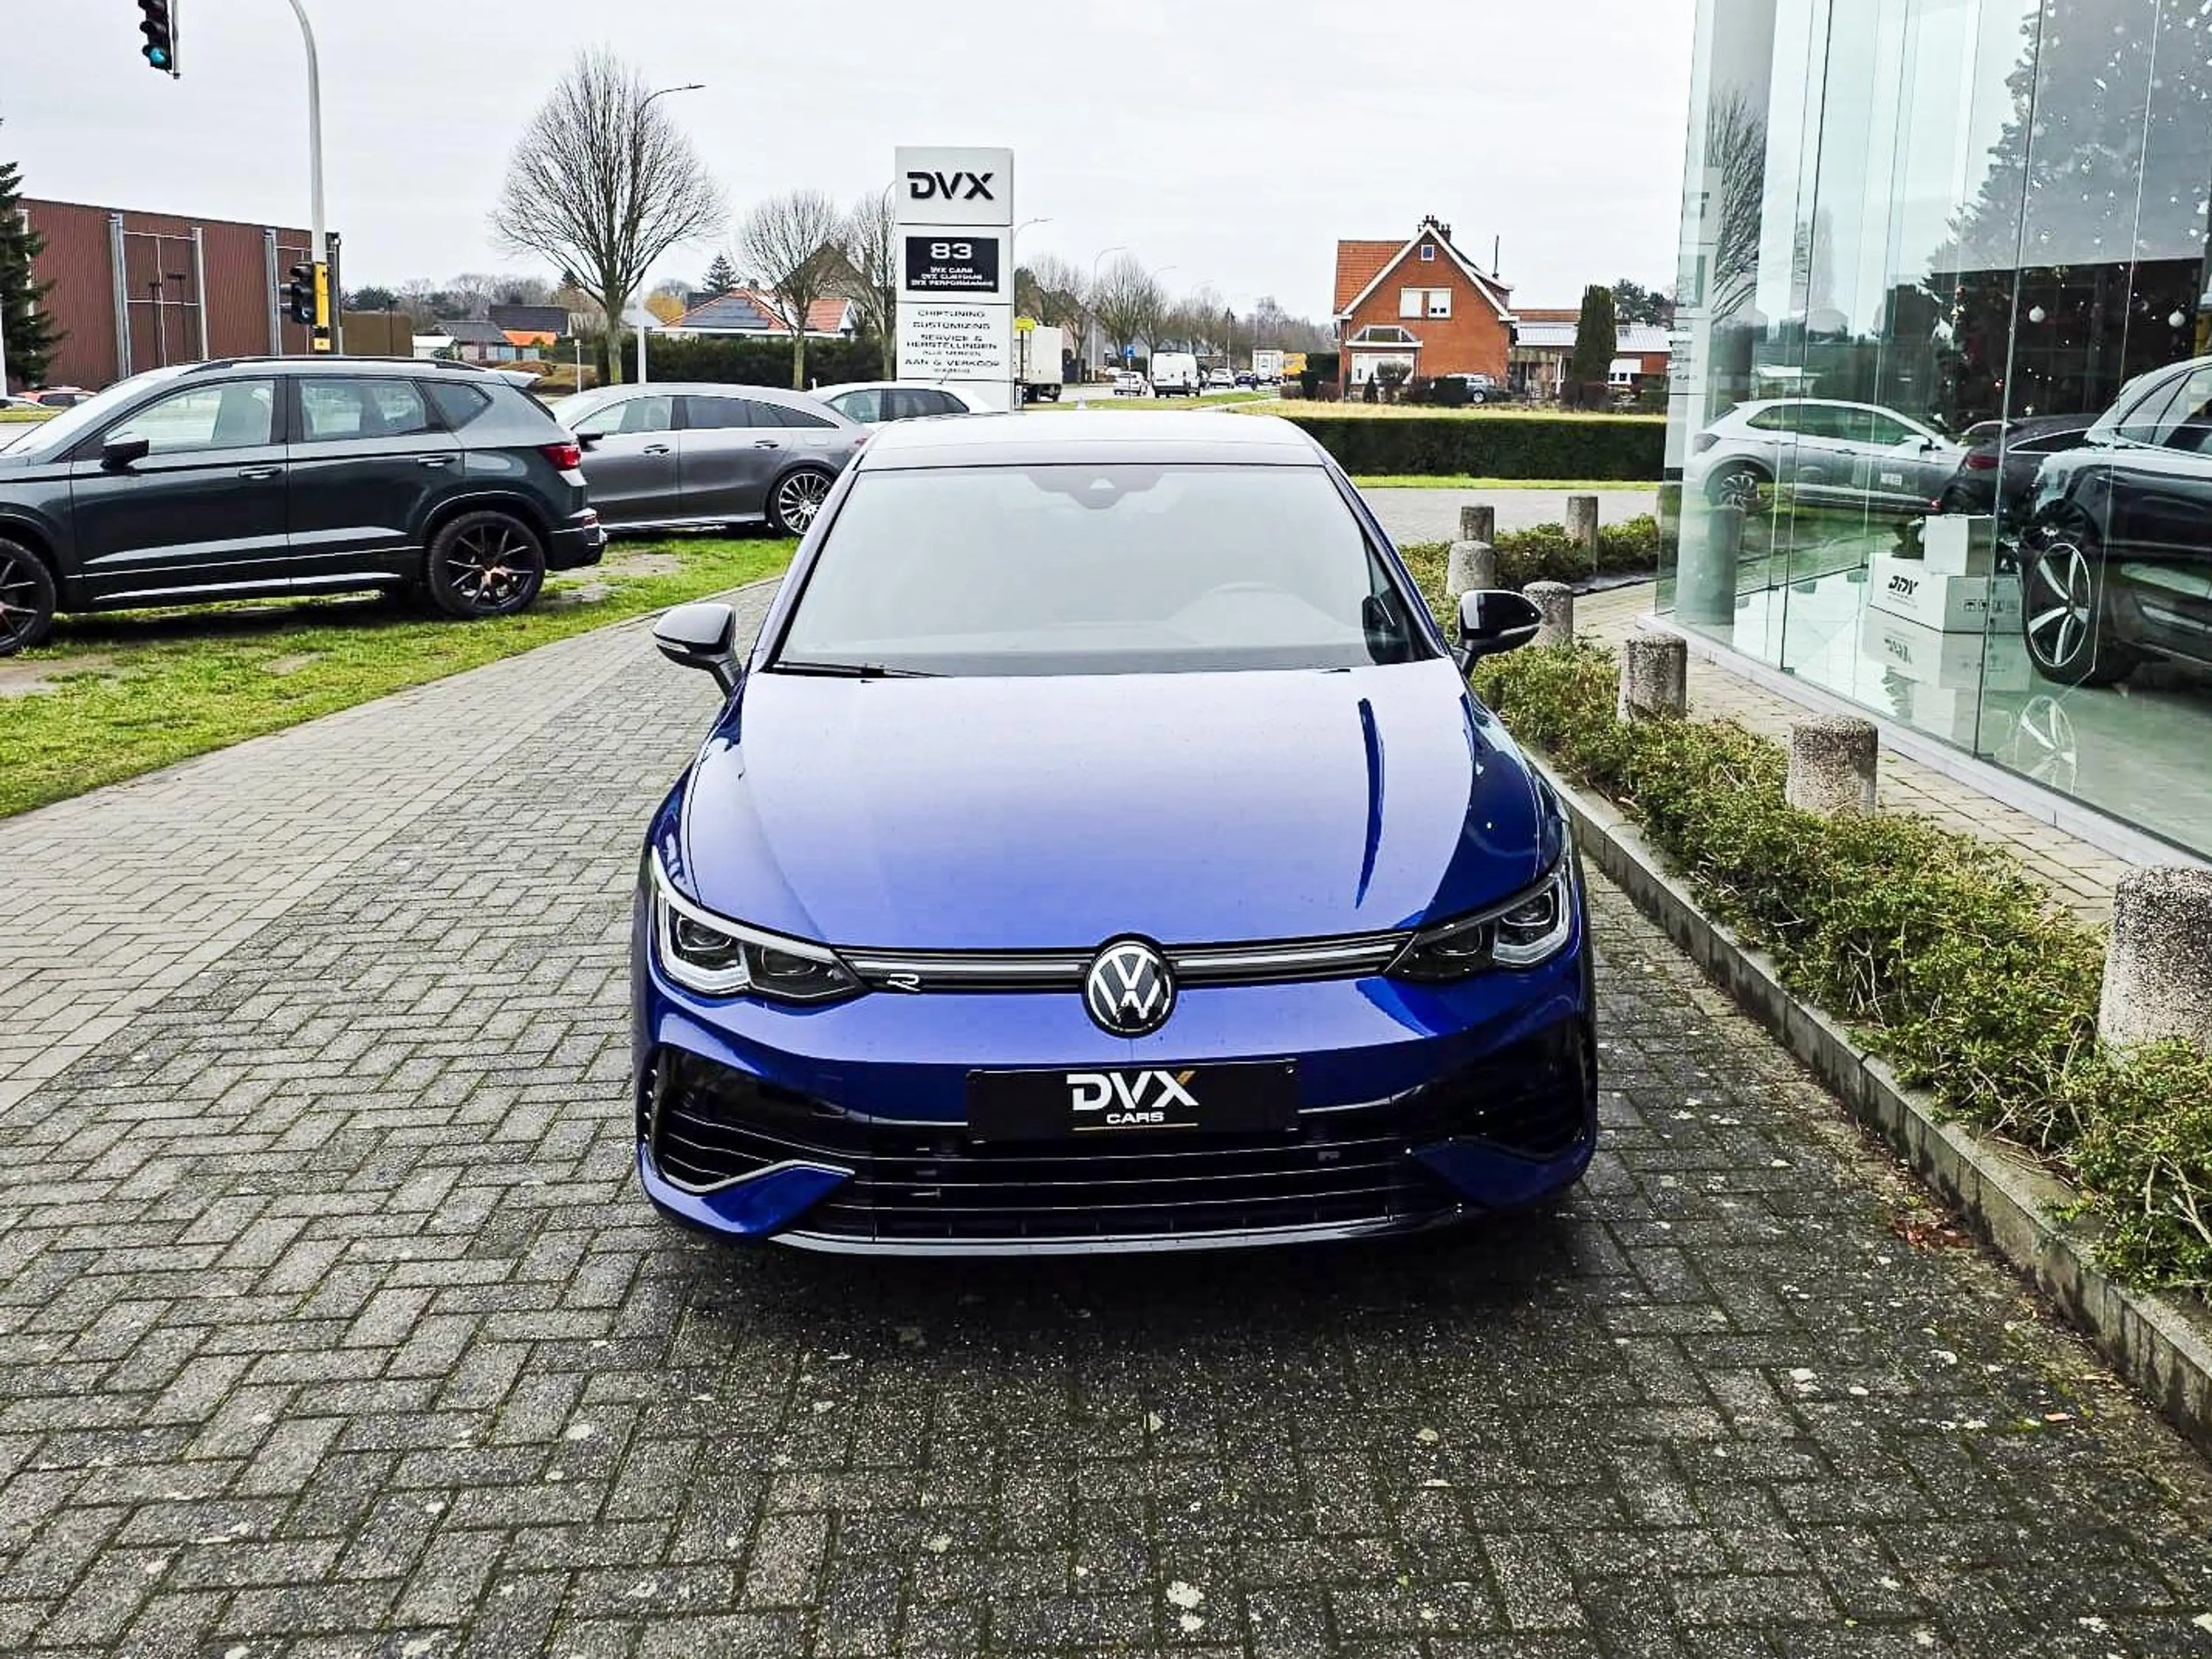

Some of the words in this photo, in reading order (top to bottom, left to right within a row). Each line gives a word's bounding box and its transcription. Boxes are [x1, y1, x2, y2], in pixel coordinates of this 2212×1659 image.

[907, 172, 994, 200] DVX
[930, 243, 973, 259] 83
[887, 974, 920, 991] R
[1067, 1071, 1199, 1110] DVX
[1106, 1111, 1164, 1124] CARS
